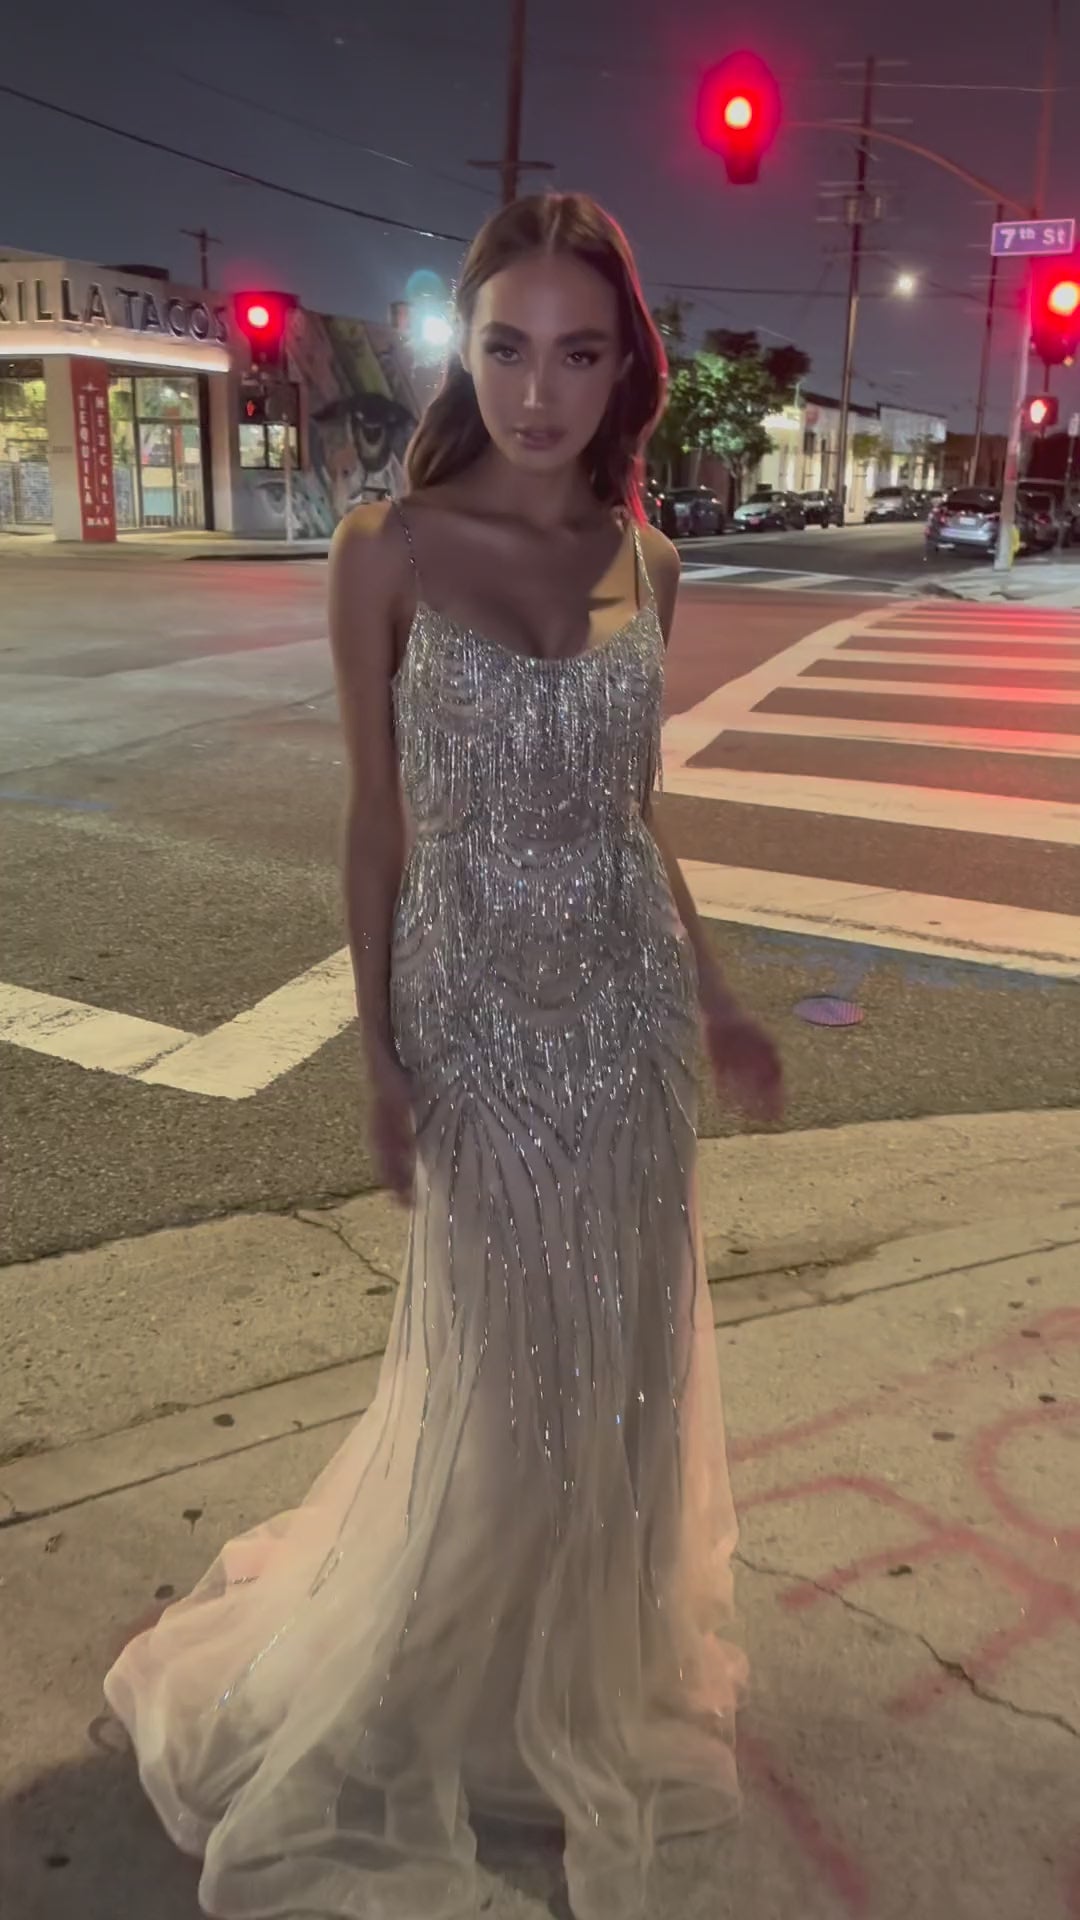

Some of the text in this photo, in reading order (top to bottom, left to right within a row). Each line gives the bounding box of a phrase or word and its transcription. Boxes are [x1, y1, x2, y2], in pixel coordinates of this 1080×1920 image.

[1000, 228, 1066, 249] 7th St
[114, 287, 229, 345] TACOS
[78, 394, 93, 505] TEQUILA
